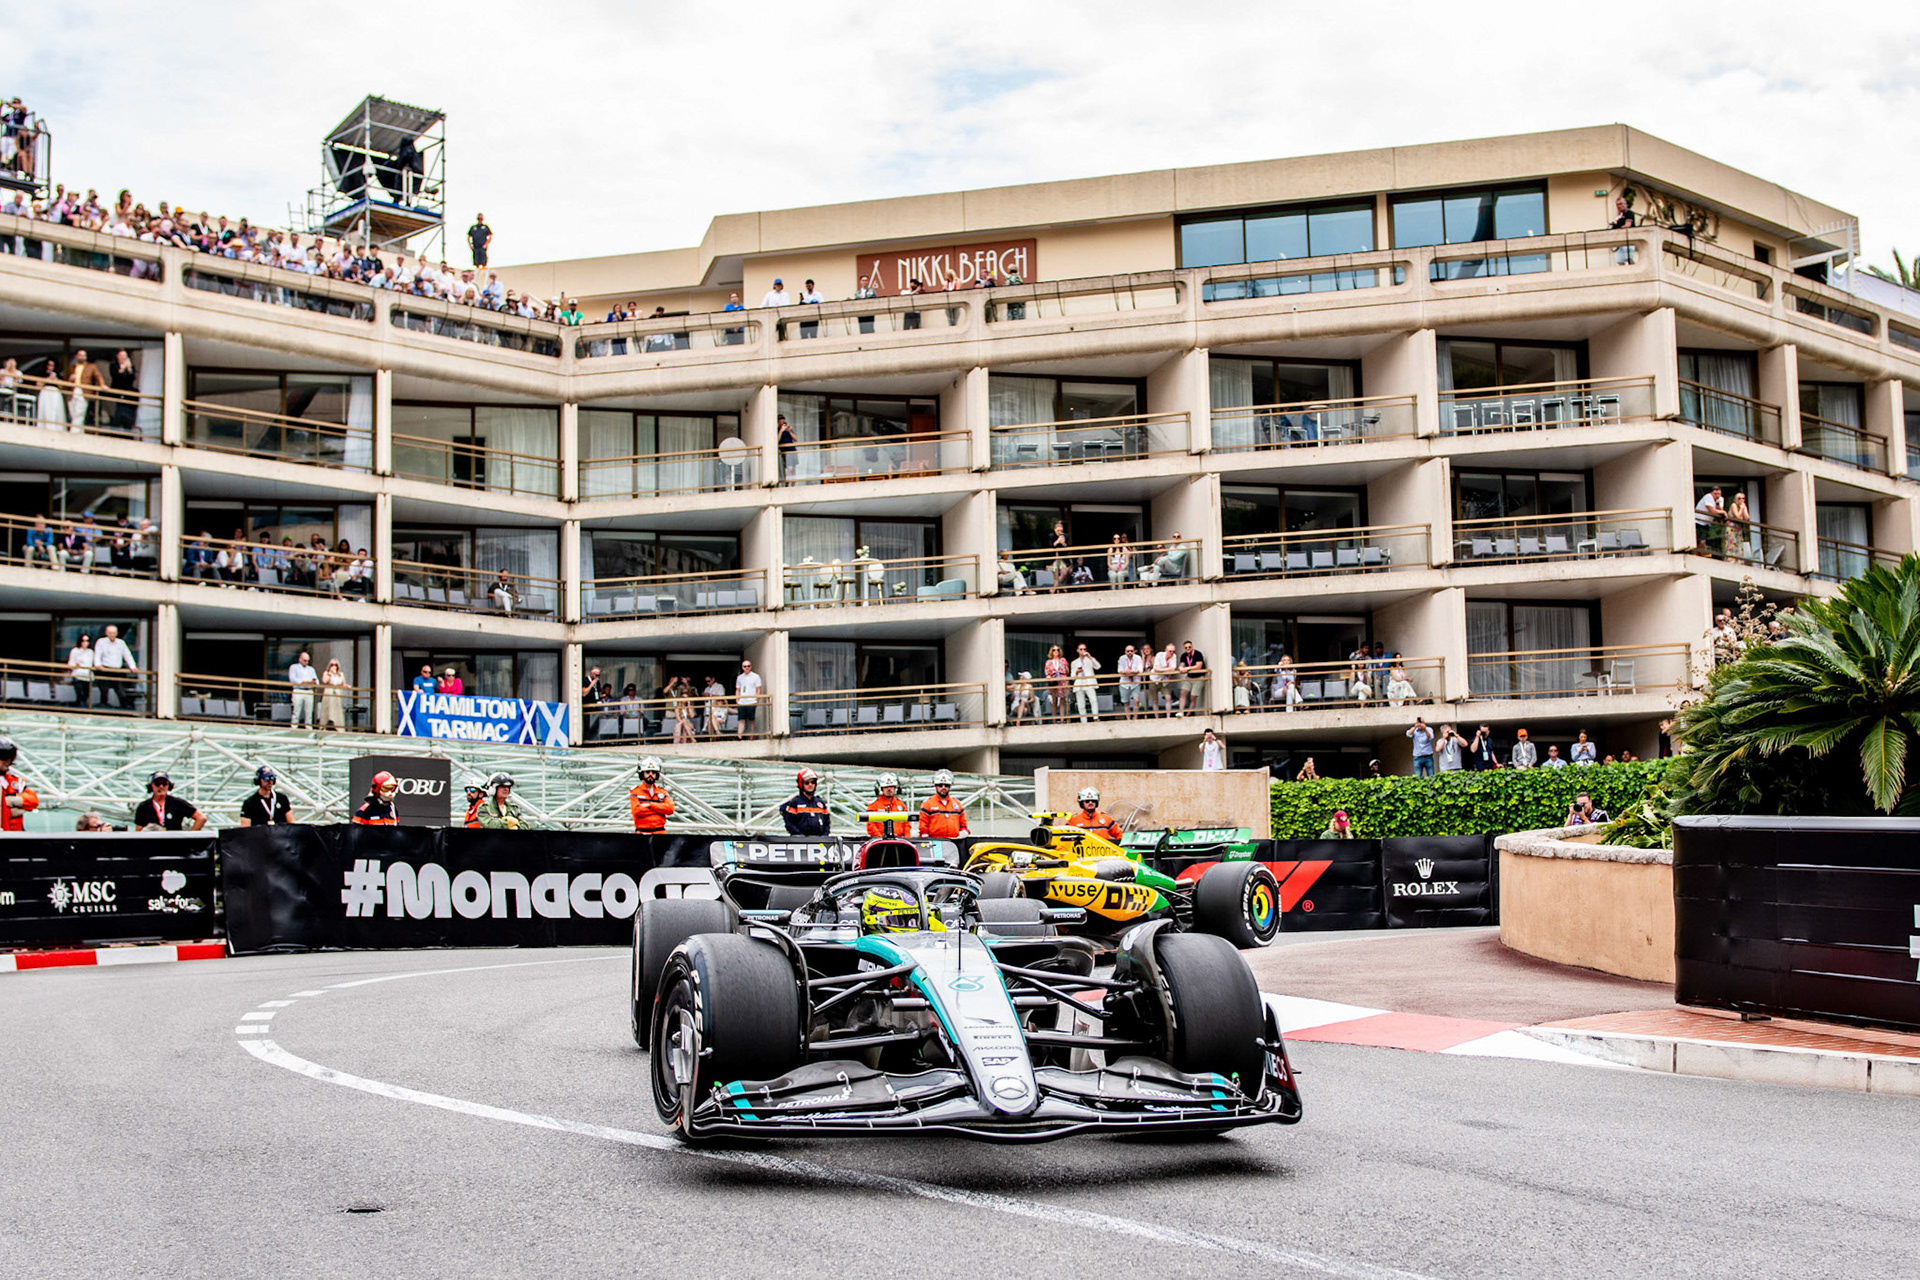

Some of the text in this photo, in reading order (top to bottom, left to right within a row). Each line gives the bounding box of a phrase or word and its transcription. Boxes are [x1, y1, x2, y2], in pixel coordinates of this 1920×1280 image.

[898, 247, 1027, 290] NIKKI BEACH
[420, 694, 517, 720] HAMILTON
[427, 718, 510, 743] TARMAC
[395, 777, 446, 796] OBU
[749, 842, 862, 862] PETRO
[71, 881, 116, 903] MSC
[1393, 881, 1460, 897] ROLEX
[72, 904, 117, 914] CRUISES
[746, 914, 779, 922] PETRONAS
[776, 1092, 851, 1110] PETRONAS
